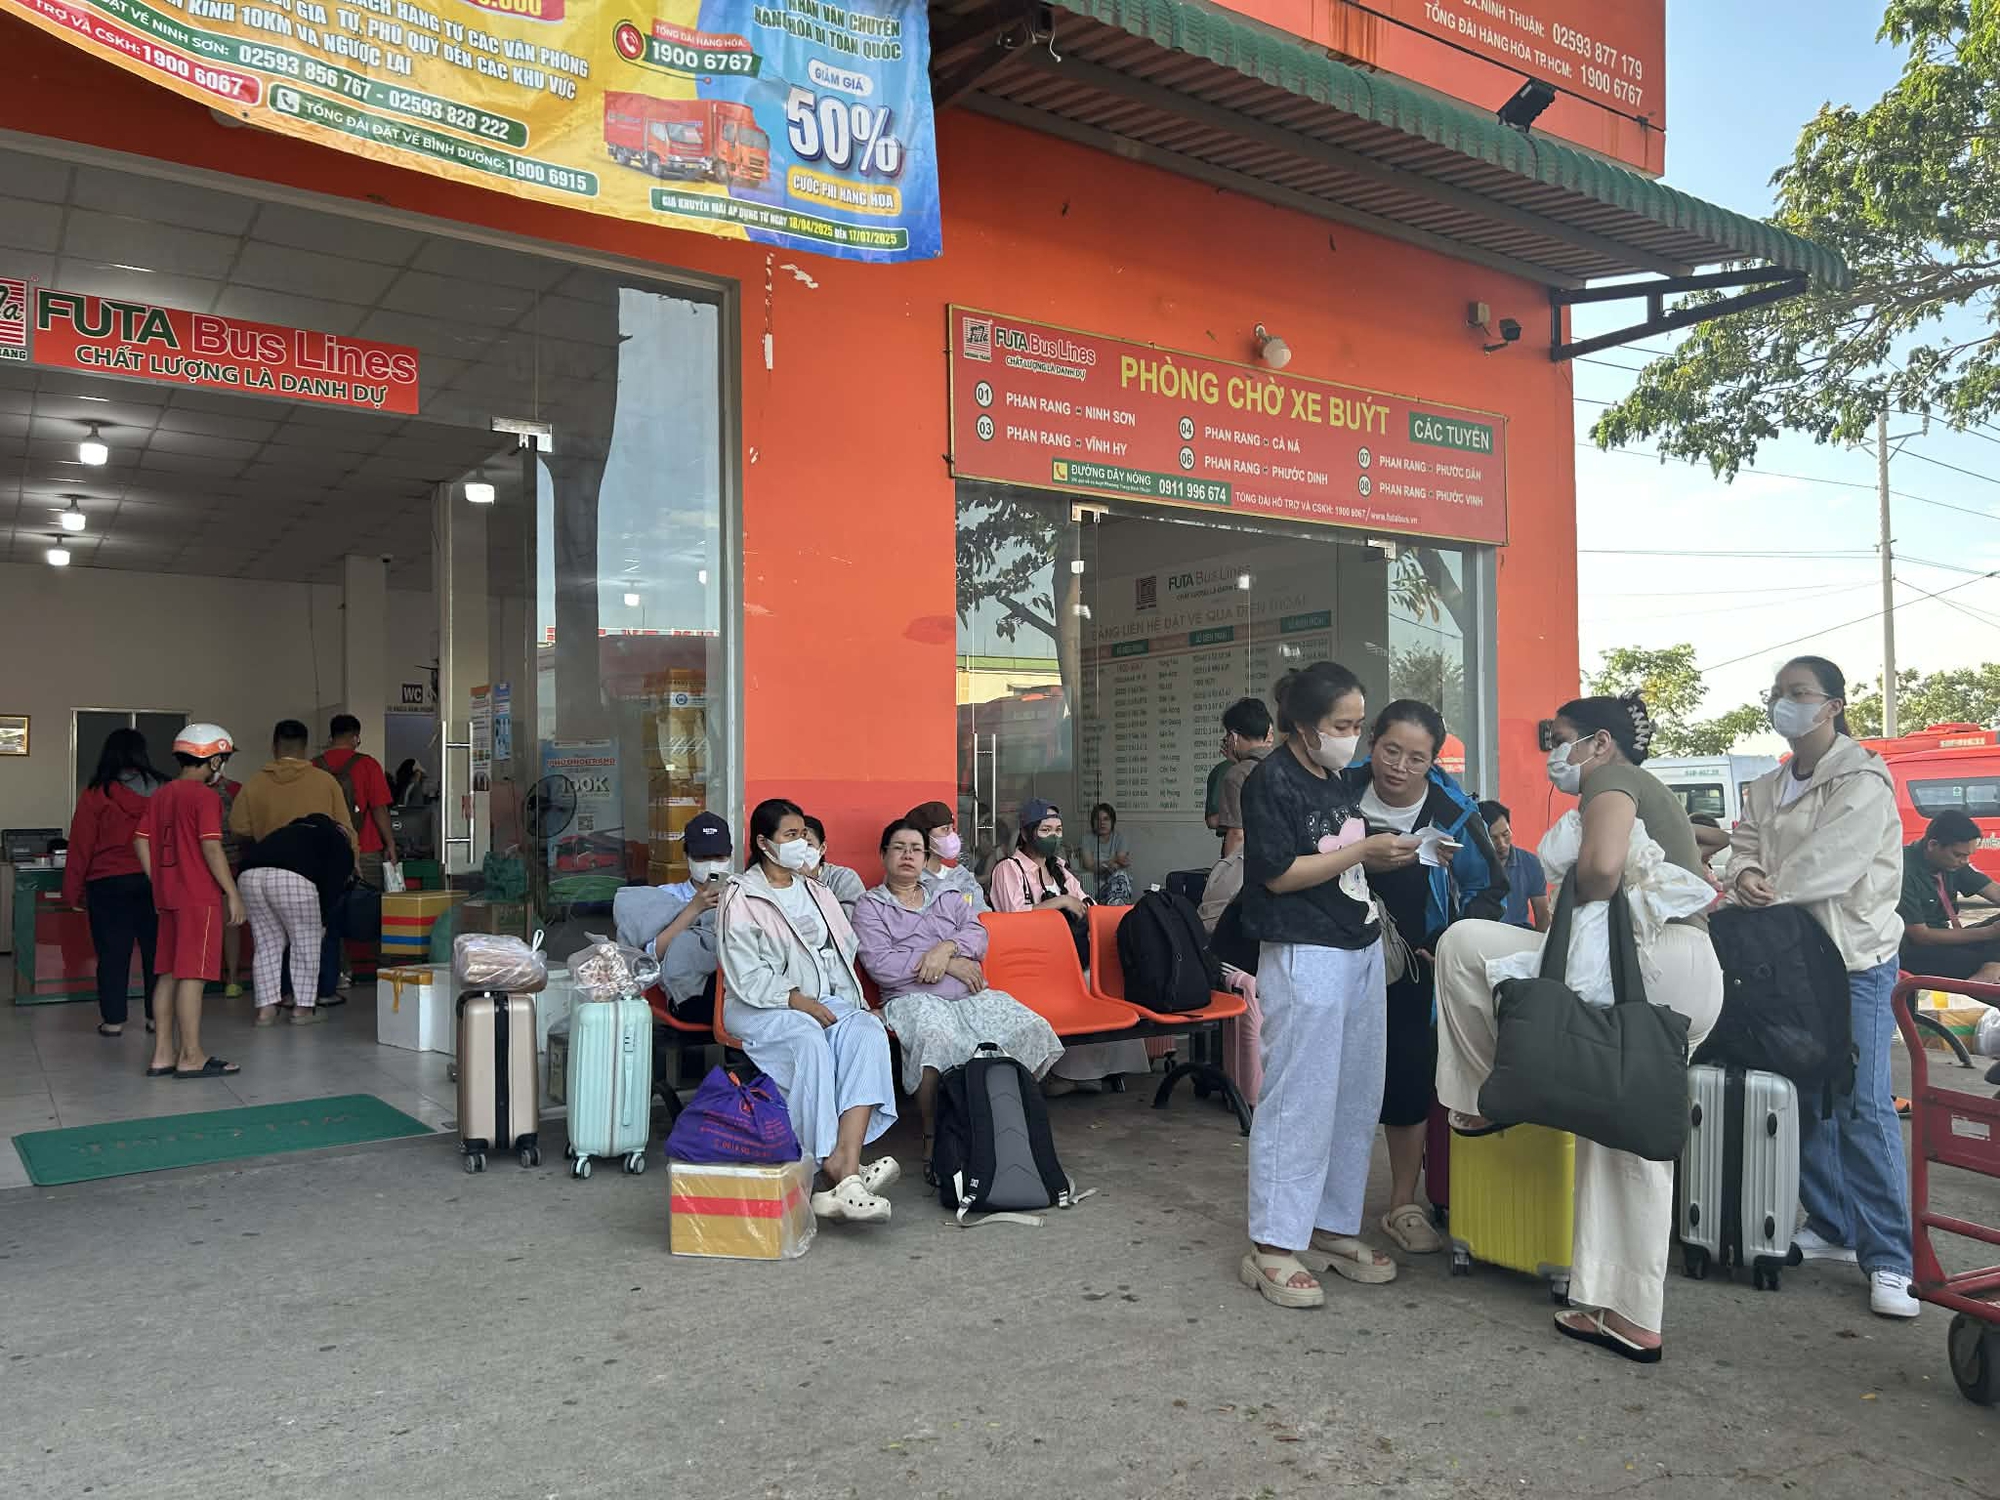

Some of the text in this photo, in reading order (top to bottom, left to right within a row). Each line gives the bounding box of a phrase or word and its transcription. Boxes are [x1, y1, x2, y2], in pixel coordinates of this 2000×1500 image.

[241, 6, 292, 36] 10KM
[95, 27, 140, 54] CSKH:
[143, 45, 189, 77] 1900
[194, 68, 243, 96] 6067
[652, 41, 753, 71] 1900 6767
[1552, 23, 1592, 58] 02593
[1594, 41, 1617, 69] 877
[1621, 53, 1643, 81] 179
[153, 19, 188, 43] NINH
[239, 45, 300, 76] 02593
[304, 64, 337, 88] 856
[342, 74, 372, 100] 767
[389, 90, 442, 119] 02593
[447, 106, 477, 129] 828
[480, 117, 510, 140] 222
[512, 67, 545, 90] KHU
[1580, 65, 1610, 94] 1900
[1613, 77, 1643, 107] 6767
[787, 85, 901, 174] 50%
[507, 159, 545, 181] 1900
[549, 168, 587, 191] 6915
[37, 288, 180, 350] FUTA
[191, 312, 286, 366] Bus
[295, 327, 417, 384] Lines
[995, 327, 1096, 365] FUTA Bus Lines
[75, 345, 388, 410] CHẤT LƯỢNG LÀ DANH DỰ
[977, 387, 1135, 427] 01 PHAN RANG NINH SƠN
[1121, 355, 1389, 436] PHÒNG CHỜ XE BUÝT
[979, 421, 1127, 456] 03 PHAN RANG VĨNH HY
[1181, 422, 1192, 436] 04
[1205, 426, 1231, 441] PHAN
[1234, 431, 1260, 447] RANG
[1414, 416, 1489, 451] CÁC TUYẾN
[1181, 453, 1192, 466] 06
[1204, 456, 1231, 471] PHAN
[1234, 460, 1260, 475] RANG
[1360, 452, 1369, 464] 07
[1380, 455, 1402, 469] PHAN
[1404, 459, 1427, 473] RANG
[1071, 463, 1105, 479] ĐƯỜNG
[1126, 472, 1151, 486] NÓNG
[1159, 478, 1183, 497] 0911
[1187, 483, 1205, 499] 996
[1208, 486, 1226, 502] 674
[1360, 480, 1370, 492] 08
[1380, 482, 1402, 497] PHAN
[1404, 485, 1427, 499] RANG
[1168, 573, 1194, 591] FUTA
[403, 686, 422, 701] WC
